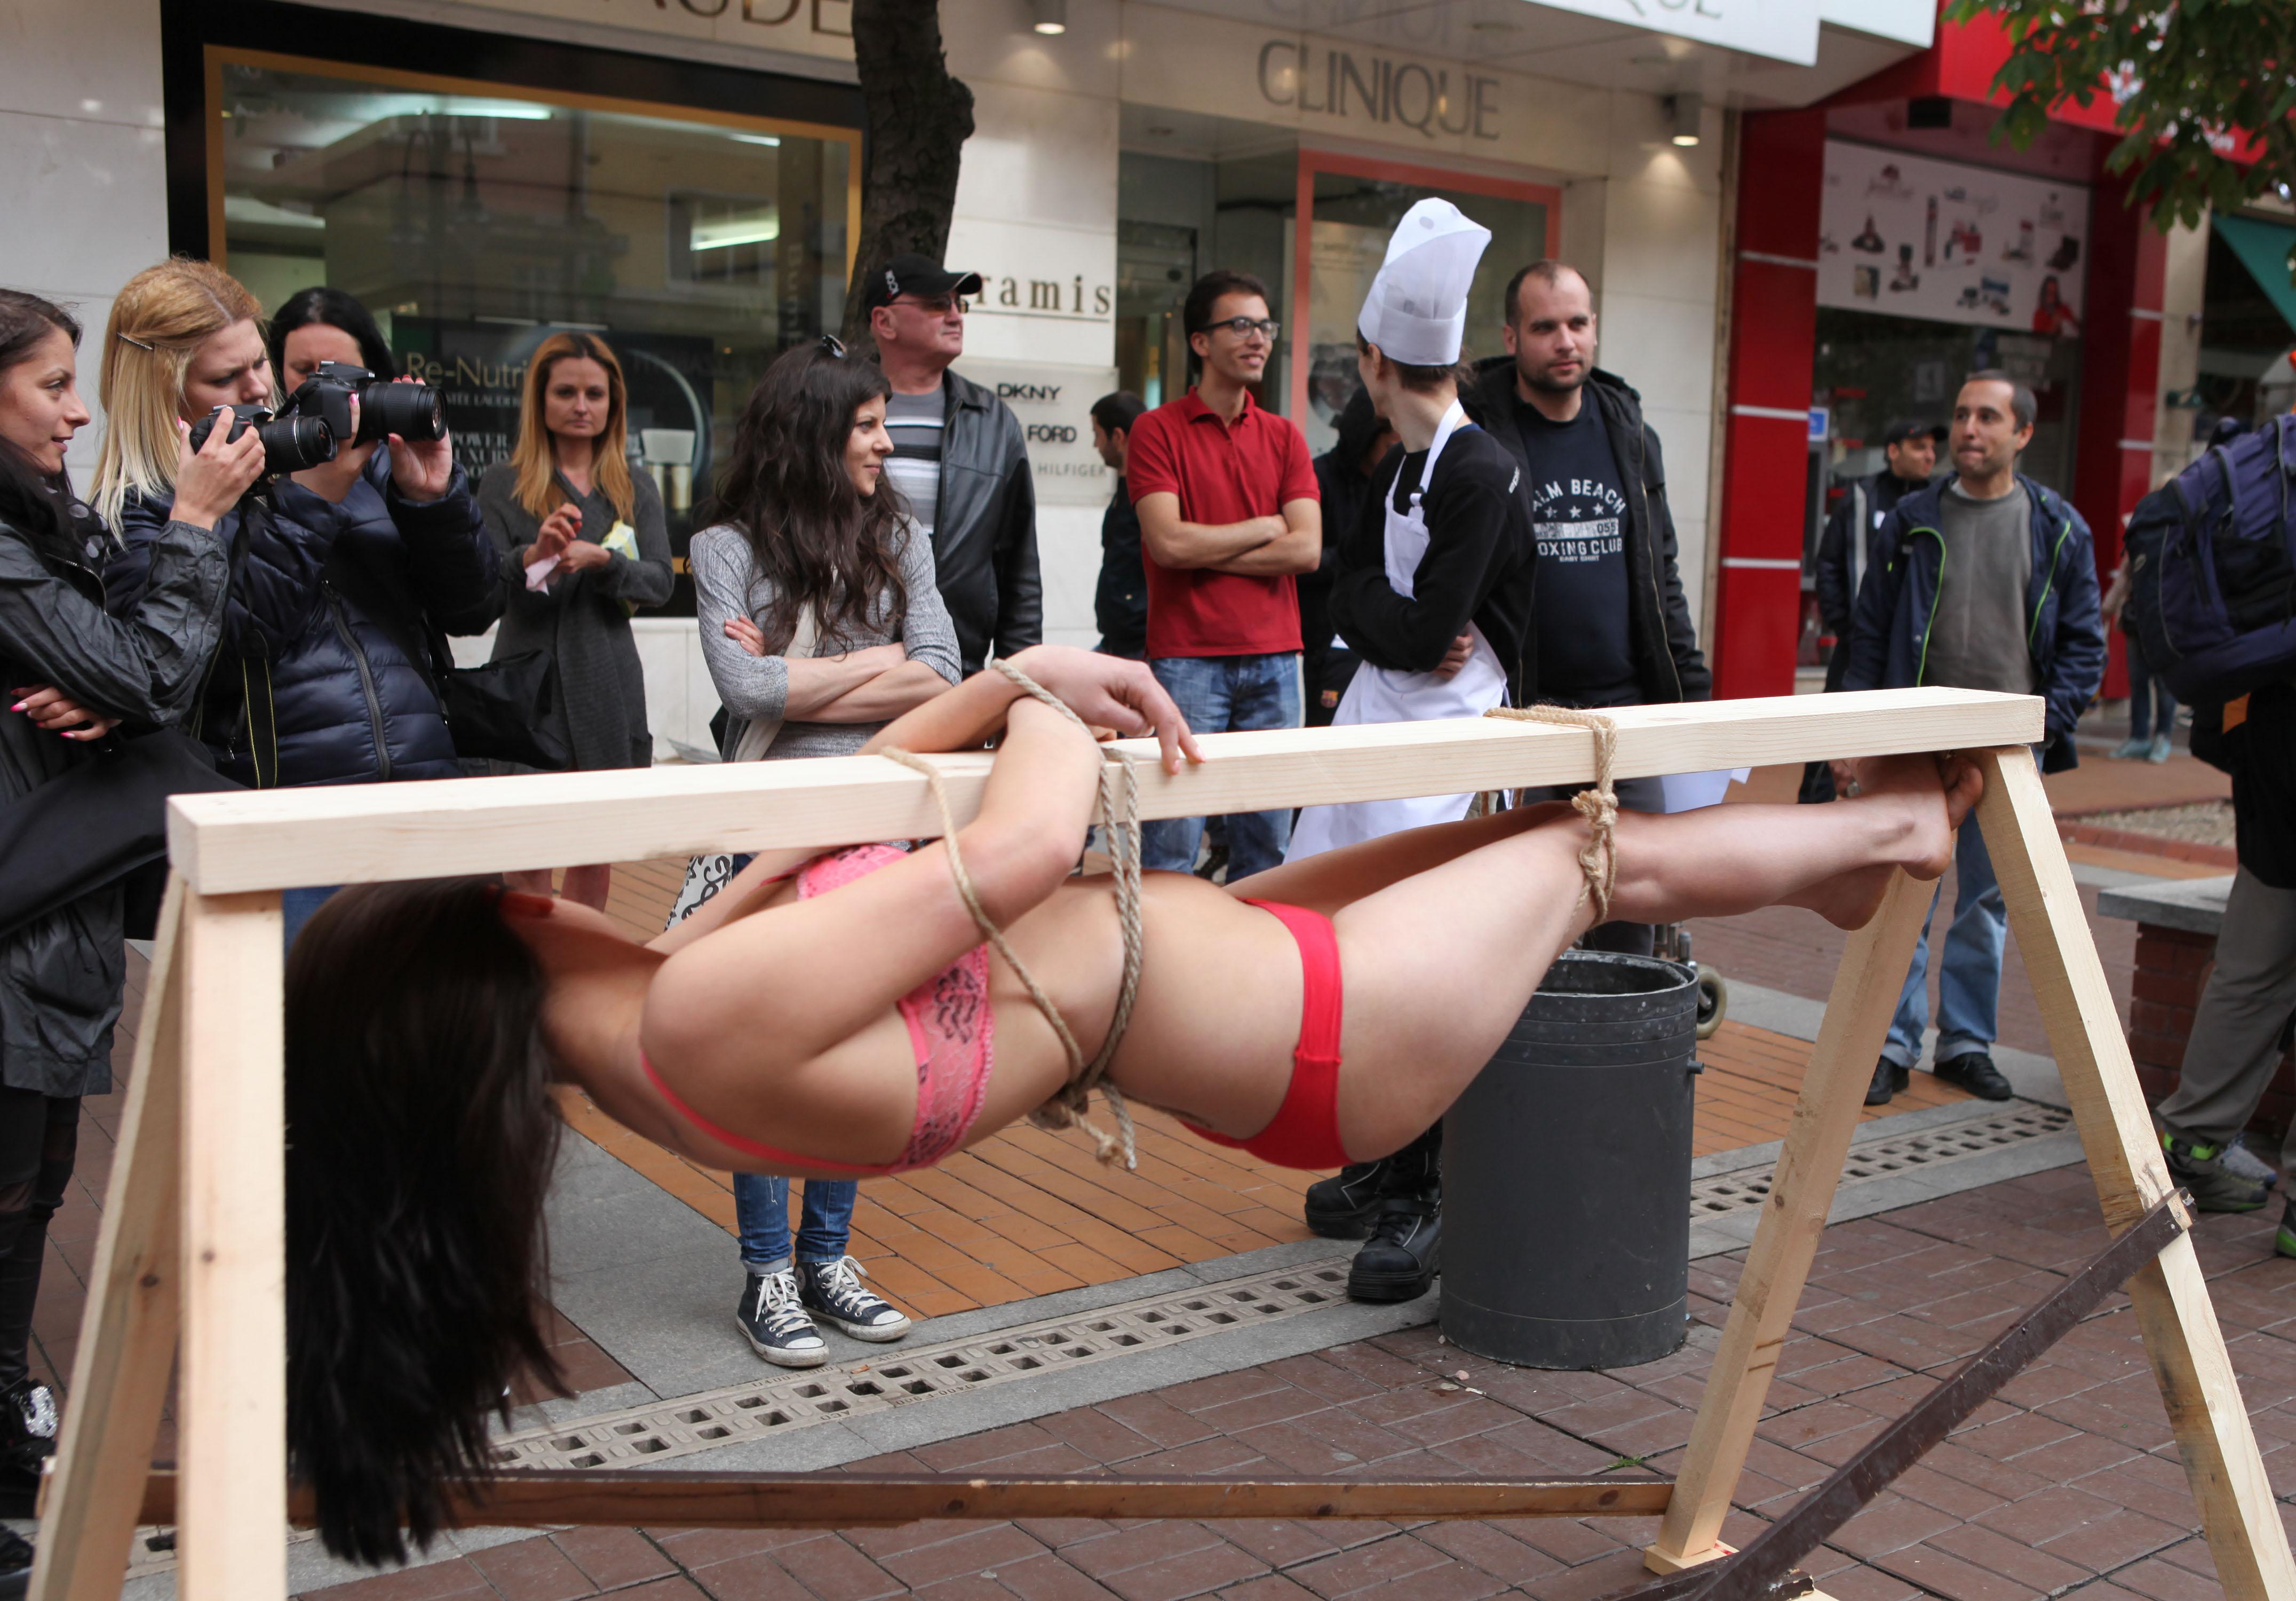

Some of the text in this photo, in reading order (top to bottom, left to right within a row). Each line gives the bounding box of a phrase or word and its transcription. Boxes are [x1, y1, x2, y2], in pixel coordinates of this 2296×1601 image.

[1258, 39, 1500, 141] CLINIQUE
[976, 274, 1111, 314] ramis
[997, 383, 1062, 400] DKNY
[1028, 424, 1077, 443] FORD
[1037, 462, 1107, 477] HILFIGER
[1532, 479, 1626, 514] ALM BEACH
[1597, 522, 1617, 534] 055
[1538, 537, 1623, 557] OXING CLUB
